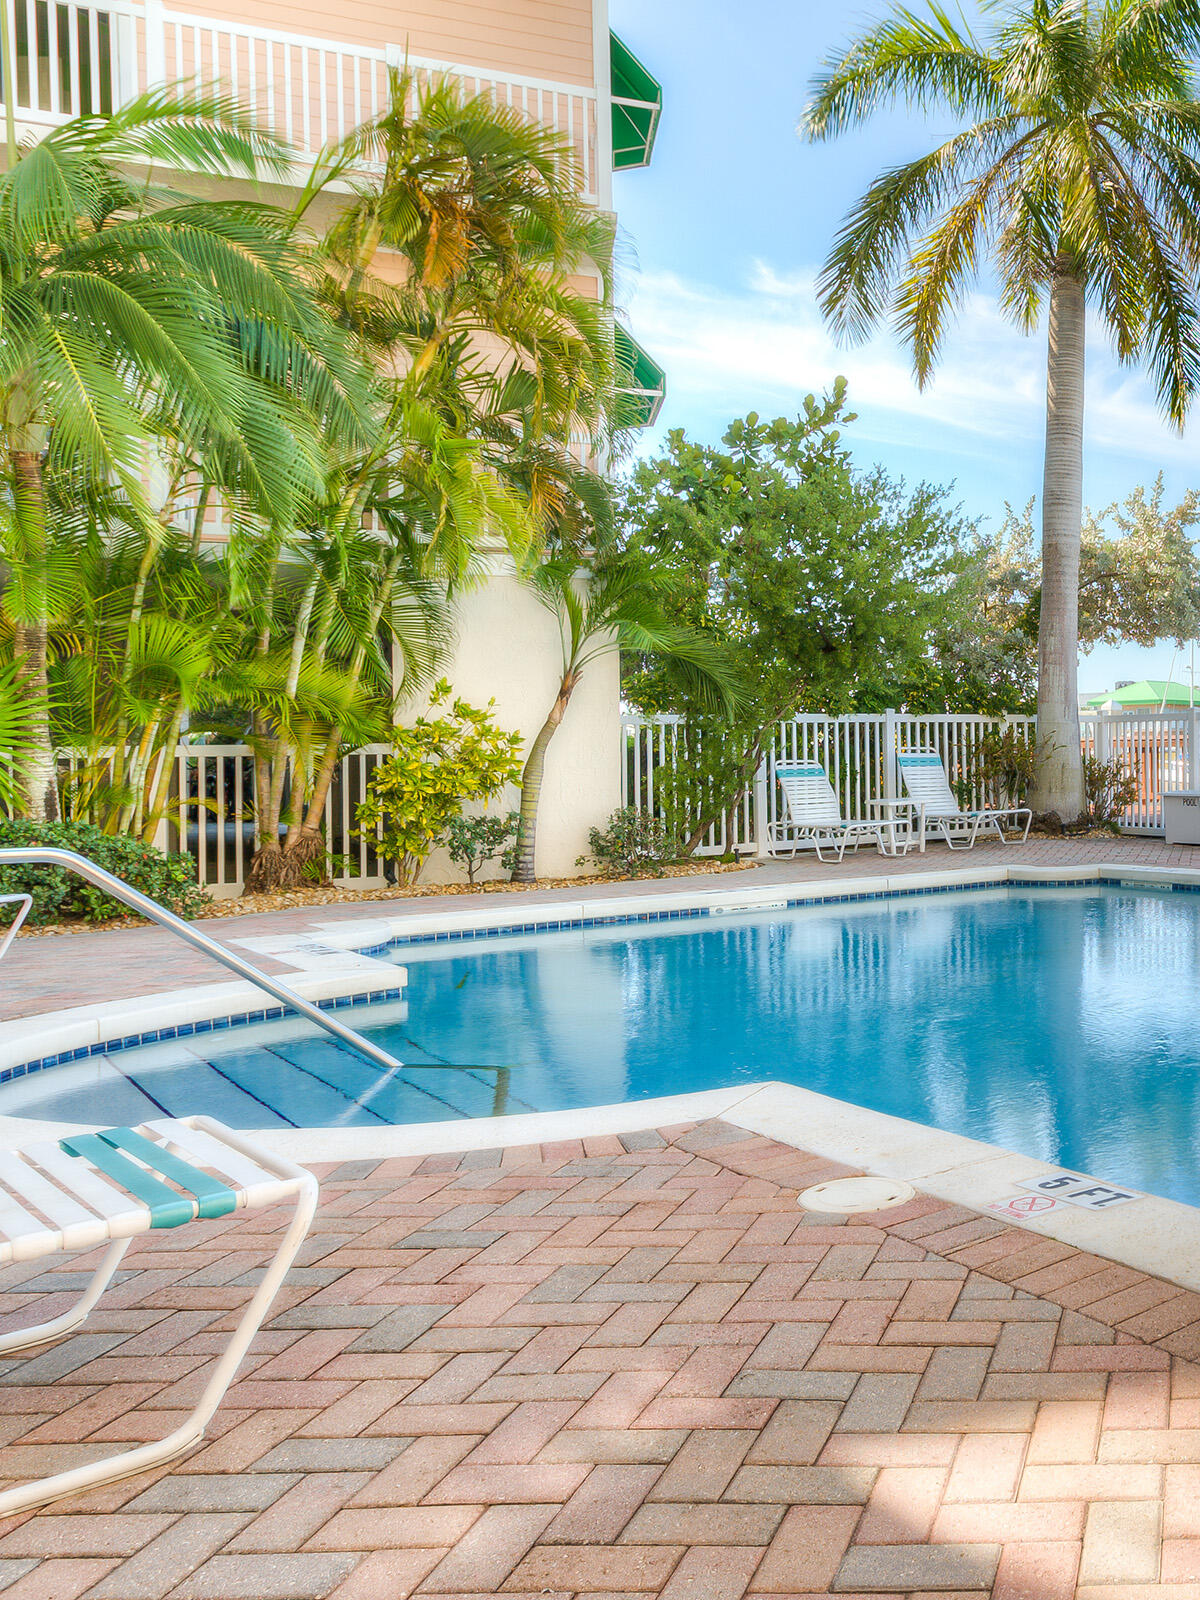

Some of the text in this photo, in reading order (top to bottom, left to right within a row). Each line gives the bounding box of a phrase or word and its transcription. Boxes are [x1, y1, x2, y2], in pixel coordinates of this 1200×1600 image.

[1182, 798, 1197, 807] POOL
[1038, 1176, 1134, 1207] 5 FT.
